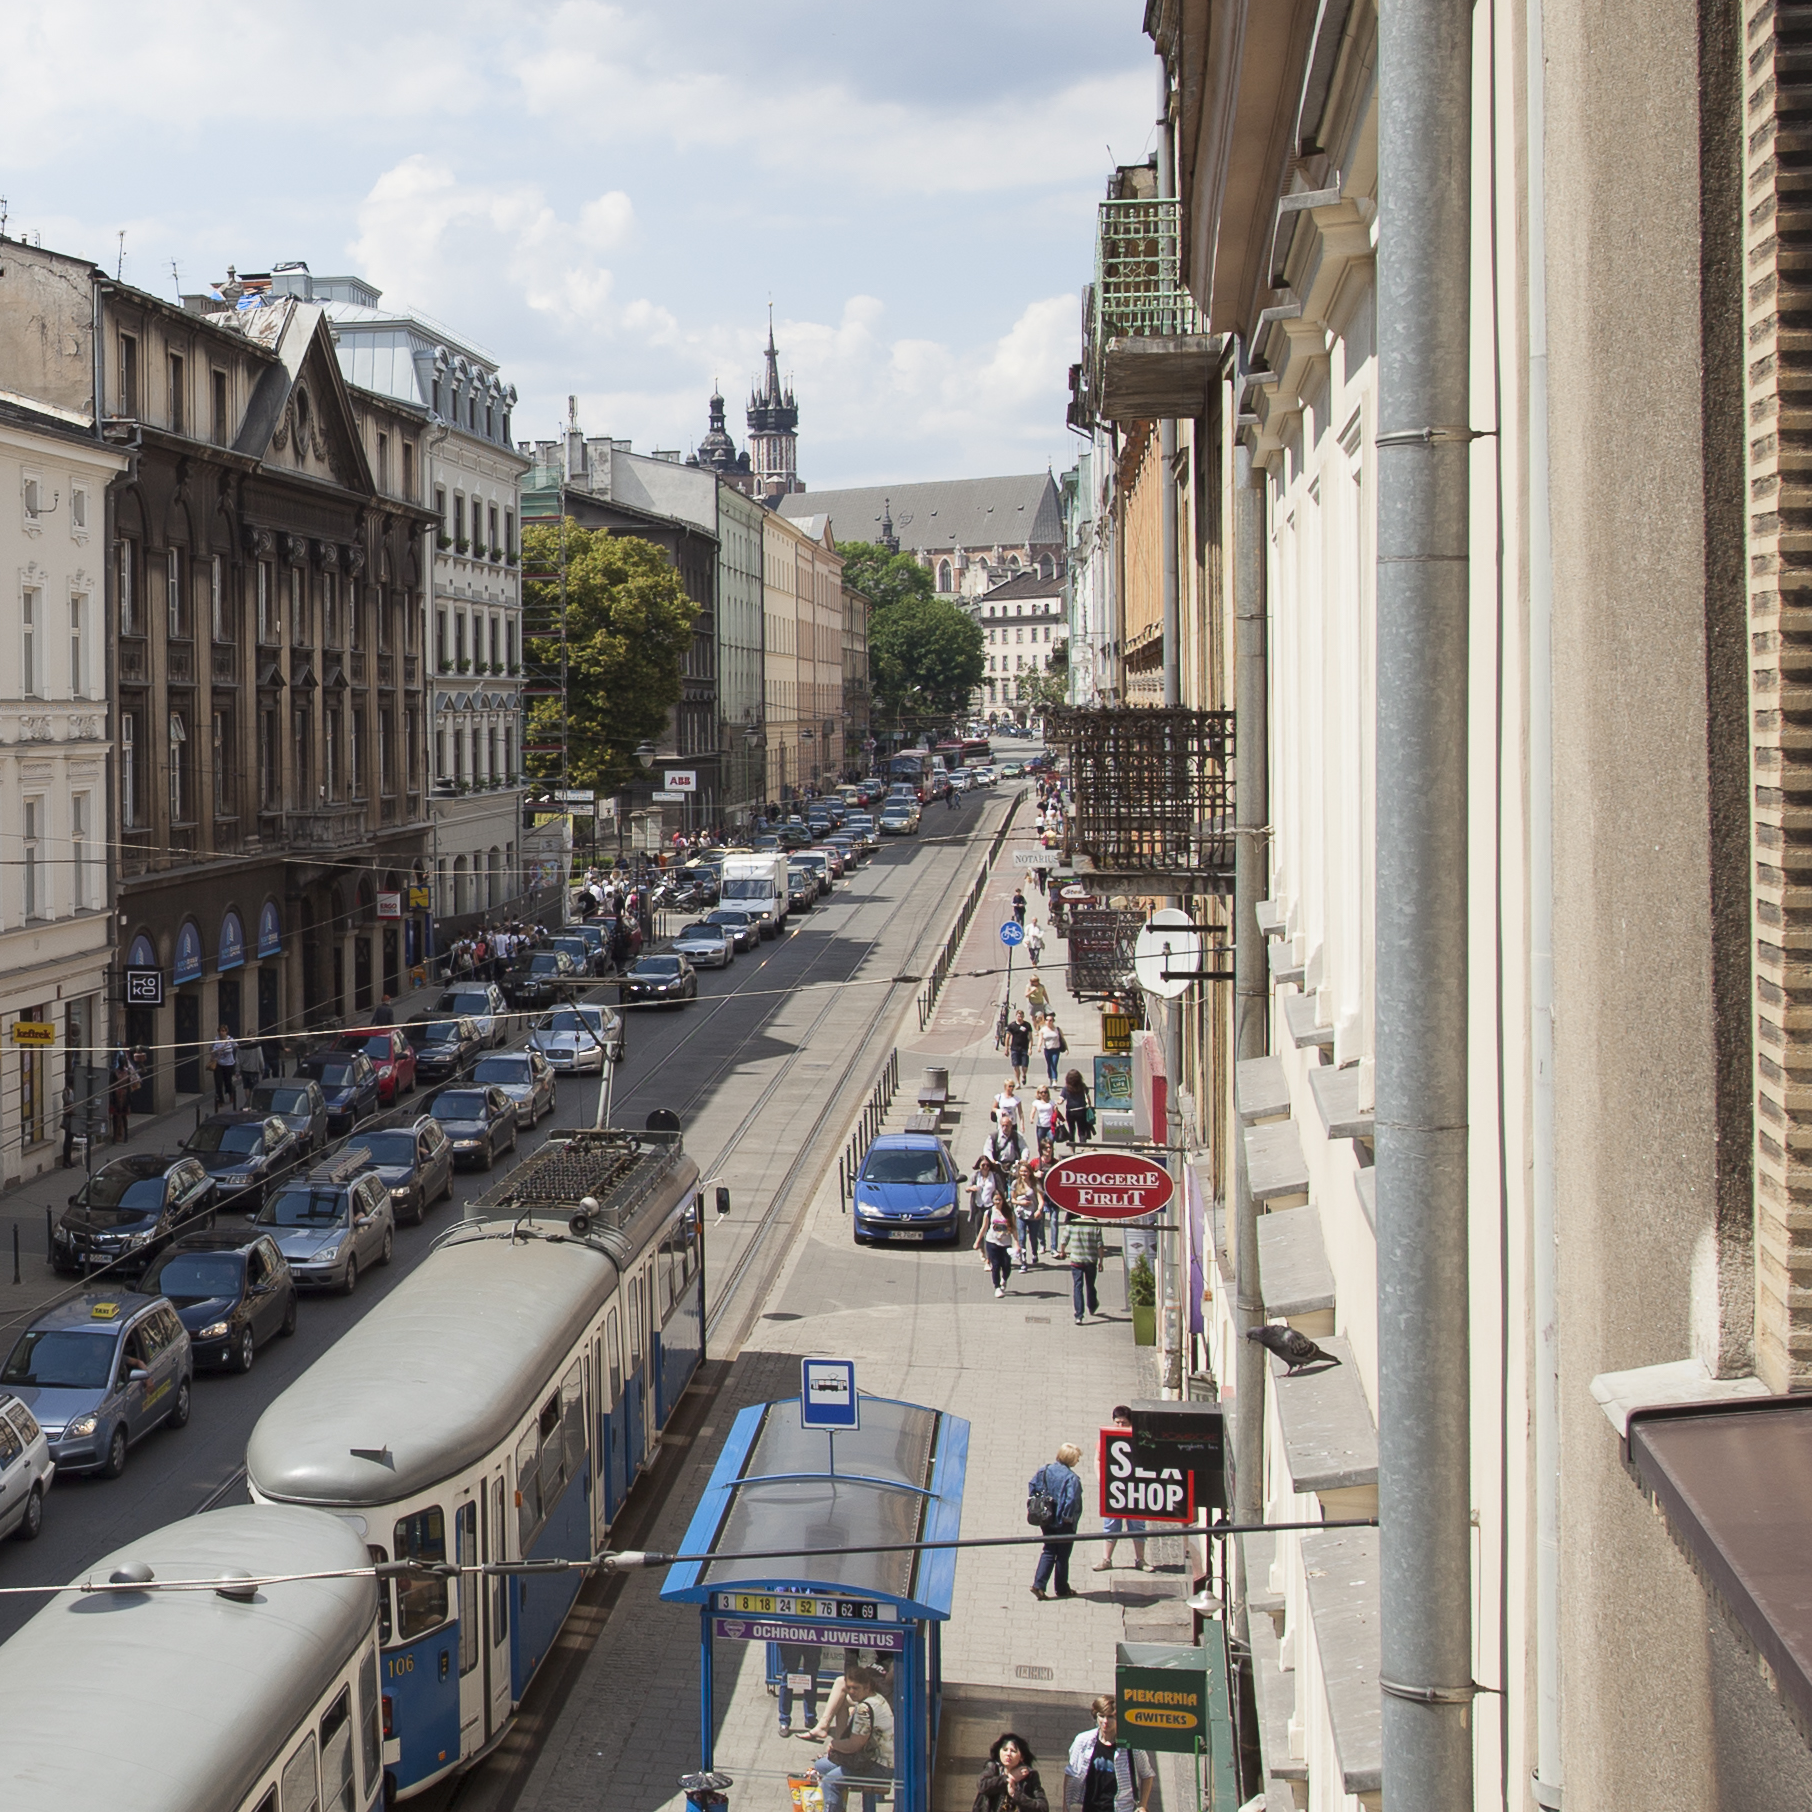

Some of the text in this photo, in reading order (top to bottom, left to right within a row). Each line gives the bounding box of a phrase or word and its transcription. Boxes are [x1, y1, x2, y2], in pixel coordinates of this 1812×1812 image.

[670, 776, 691, 785] ABB
[1059, 1170, 1159, 1186] DROGERIE
[1078, 1189, 1145, 1206] FIRLIT
[1109, 1481, 1183, 1511] SHOP
[723, 1595, 874, 1618] 3 8 18 24 52 76 62 69
[753, 1625, 817, 1641] OCHRONA
[820, 1630, 894, 1647] JUWENTUS
[388, 1654, 414, 1679] 106
[1124, 1689, 1198, 1706] PIEKARNIA
[1134, 1711, 1187, 1725] AWITEKS
